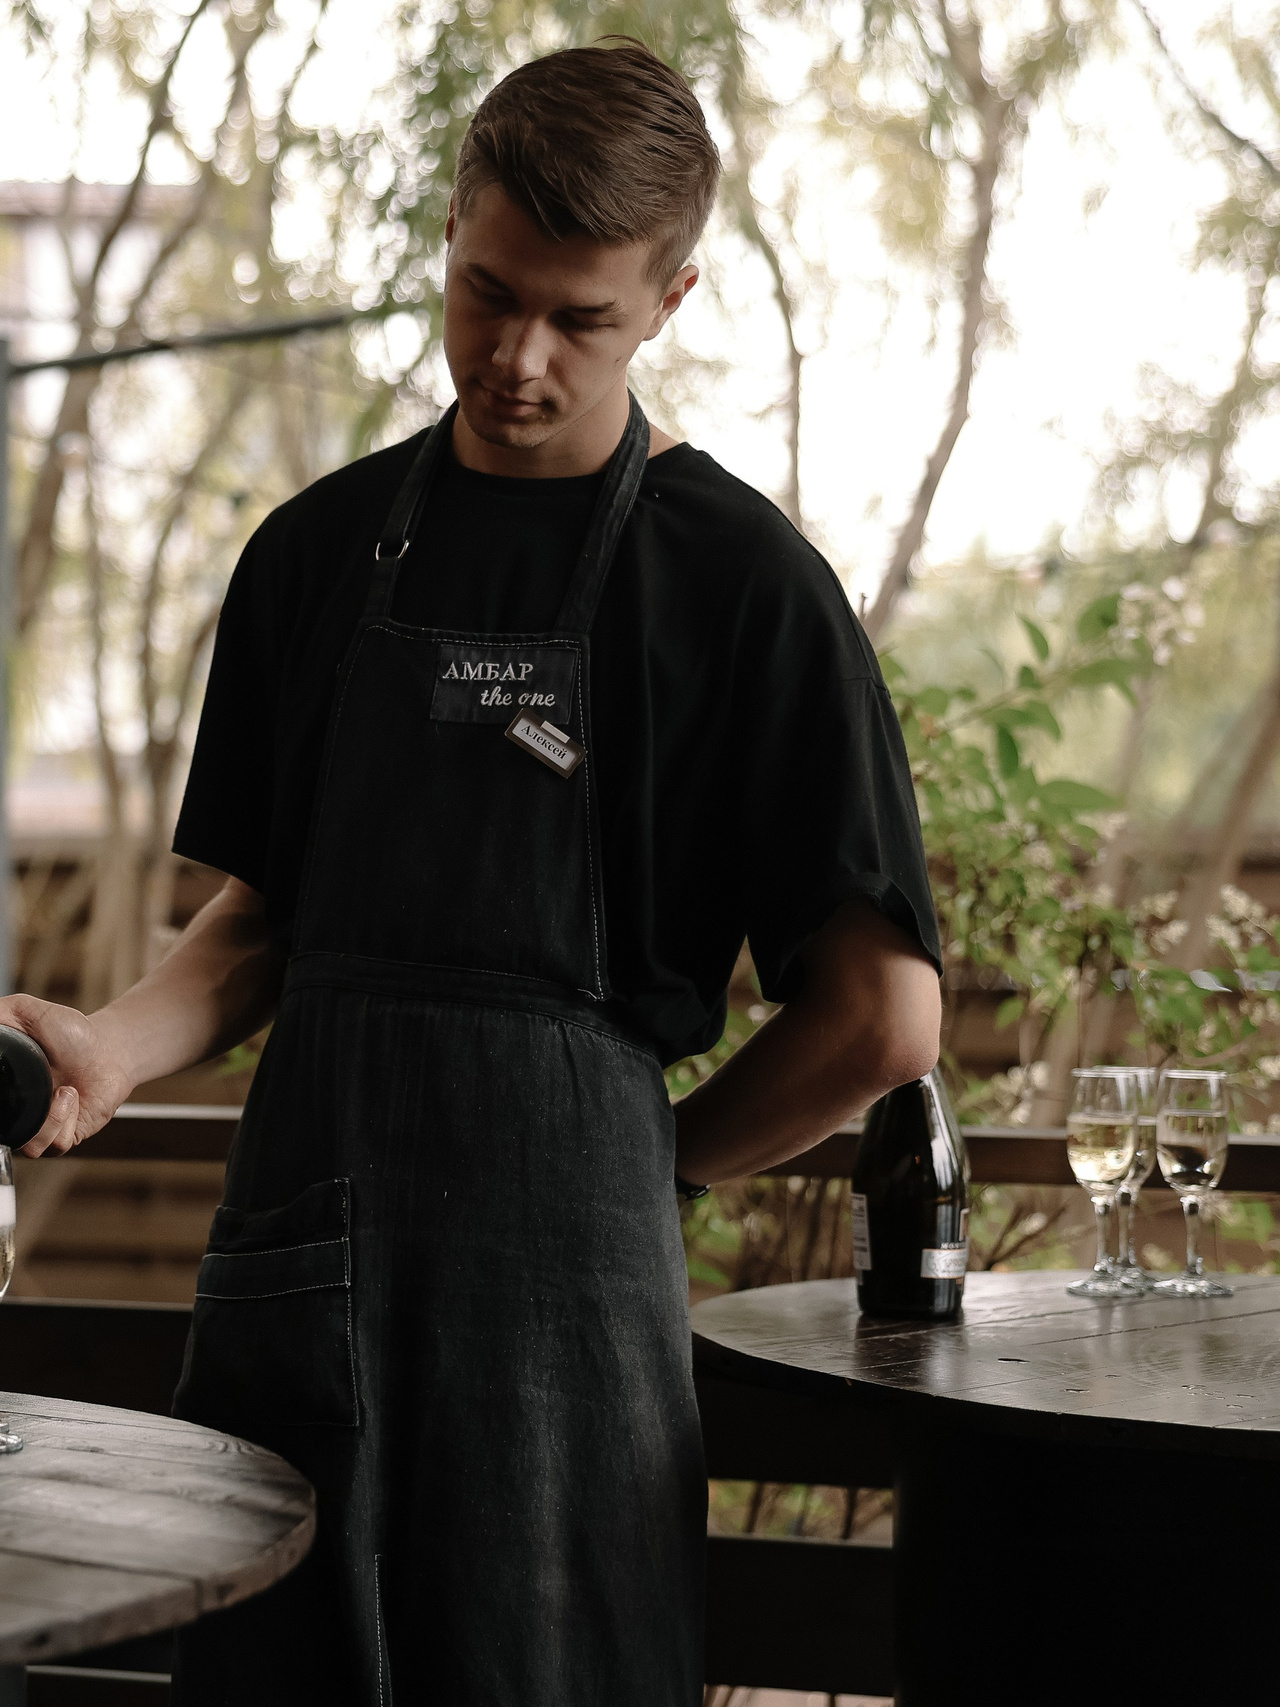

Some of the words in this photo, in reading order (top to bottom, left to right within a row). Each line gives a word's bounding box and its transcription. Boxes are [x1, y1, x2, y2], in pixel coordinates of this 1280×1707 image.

[442, 661, 534, 681] АМБАР
[480, 686, 513, 706] the
[518, 692, 556, 706] one
[521, 725, 567, 759] Алексей
